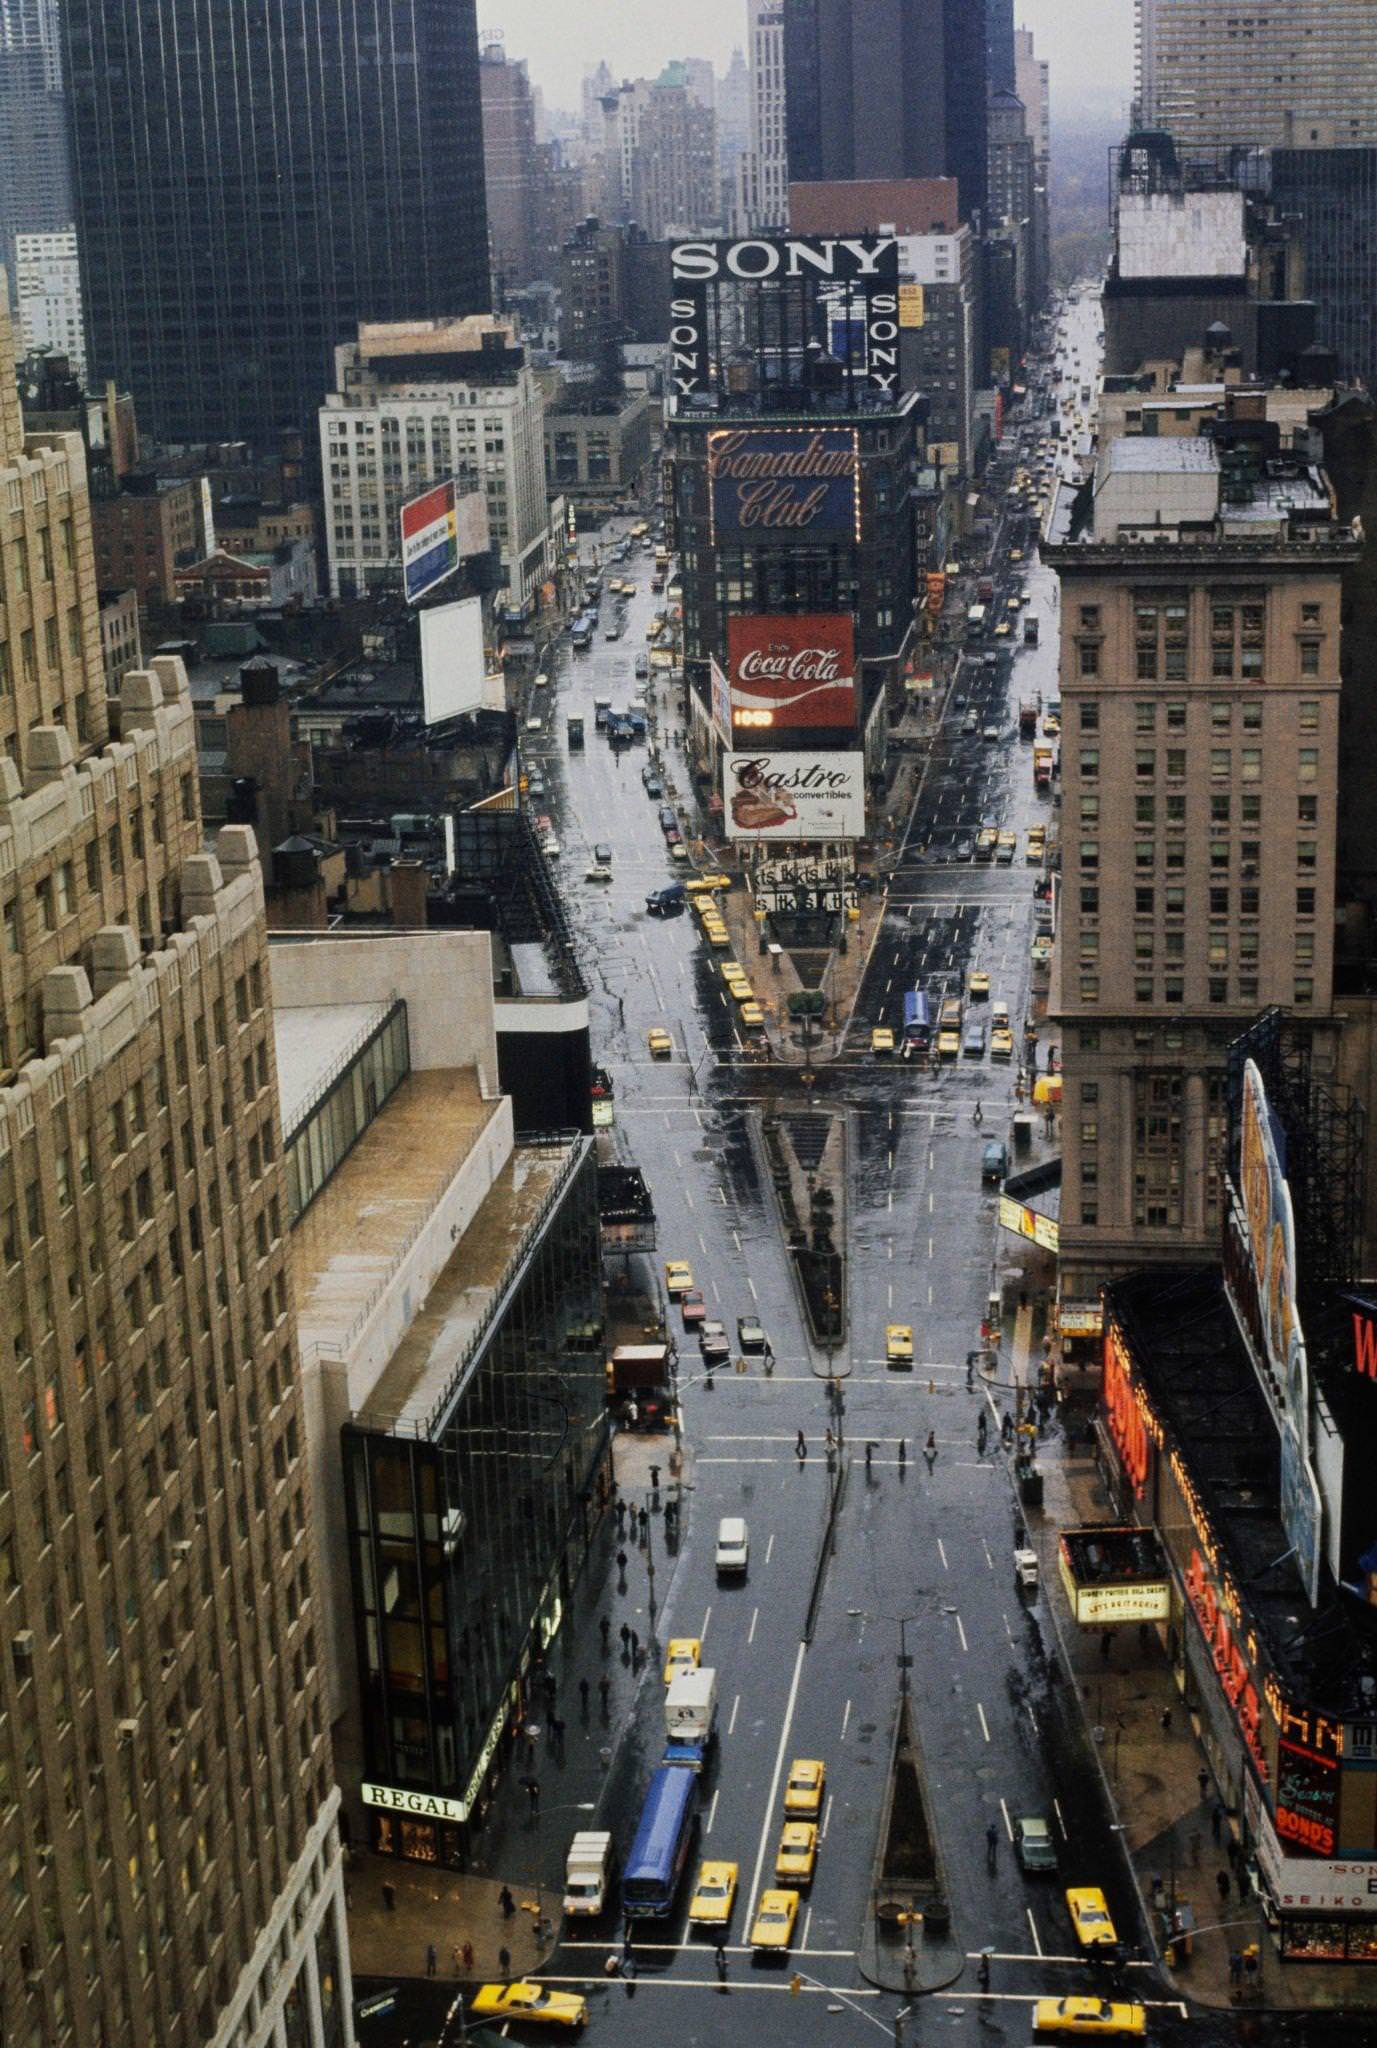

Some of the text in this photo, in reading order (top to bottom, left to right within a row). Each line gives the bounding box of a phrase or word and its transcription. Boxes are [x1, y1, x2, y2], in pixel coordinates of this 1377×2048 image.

[671, 239, 898, 279] SONY
[670, 299, 698, 395] SONY
[869, 294, 898, 391] SONY
[708, 432, 858, 478] Canadian
[737, 479, 829, 528] Club
[739, 649, 842, 681] Coca-Cola
[730, 758, 851, 789] Castro
[793, 789, 852, 800] convertibles
[370, 1787, 457, 1818] REGAL
[1283, 1895, 1362, 1905] SEIKO
